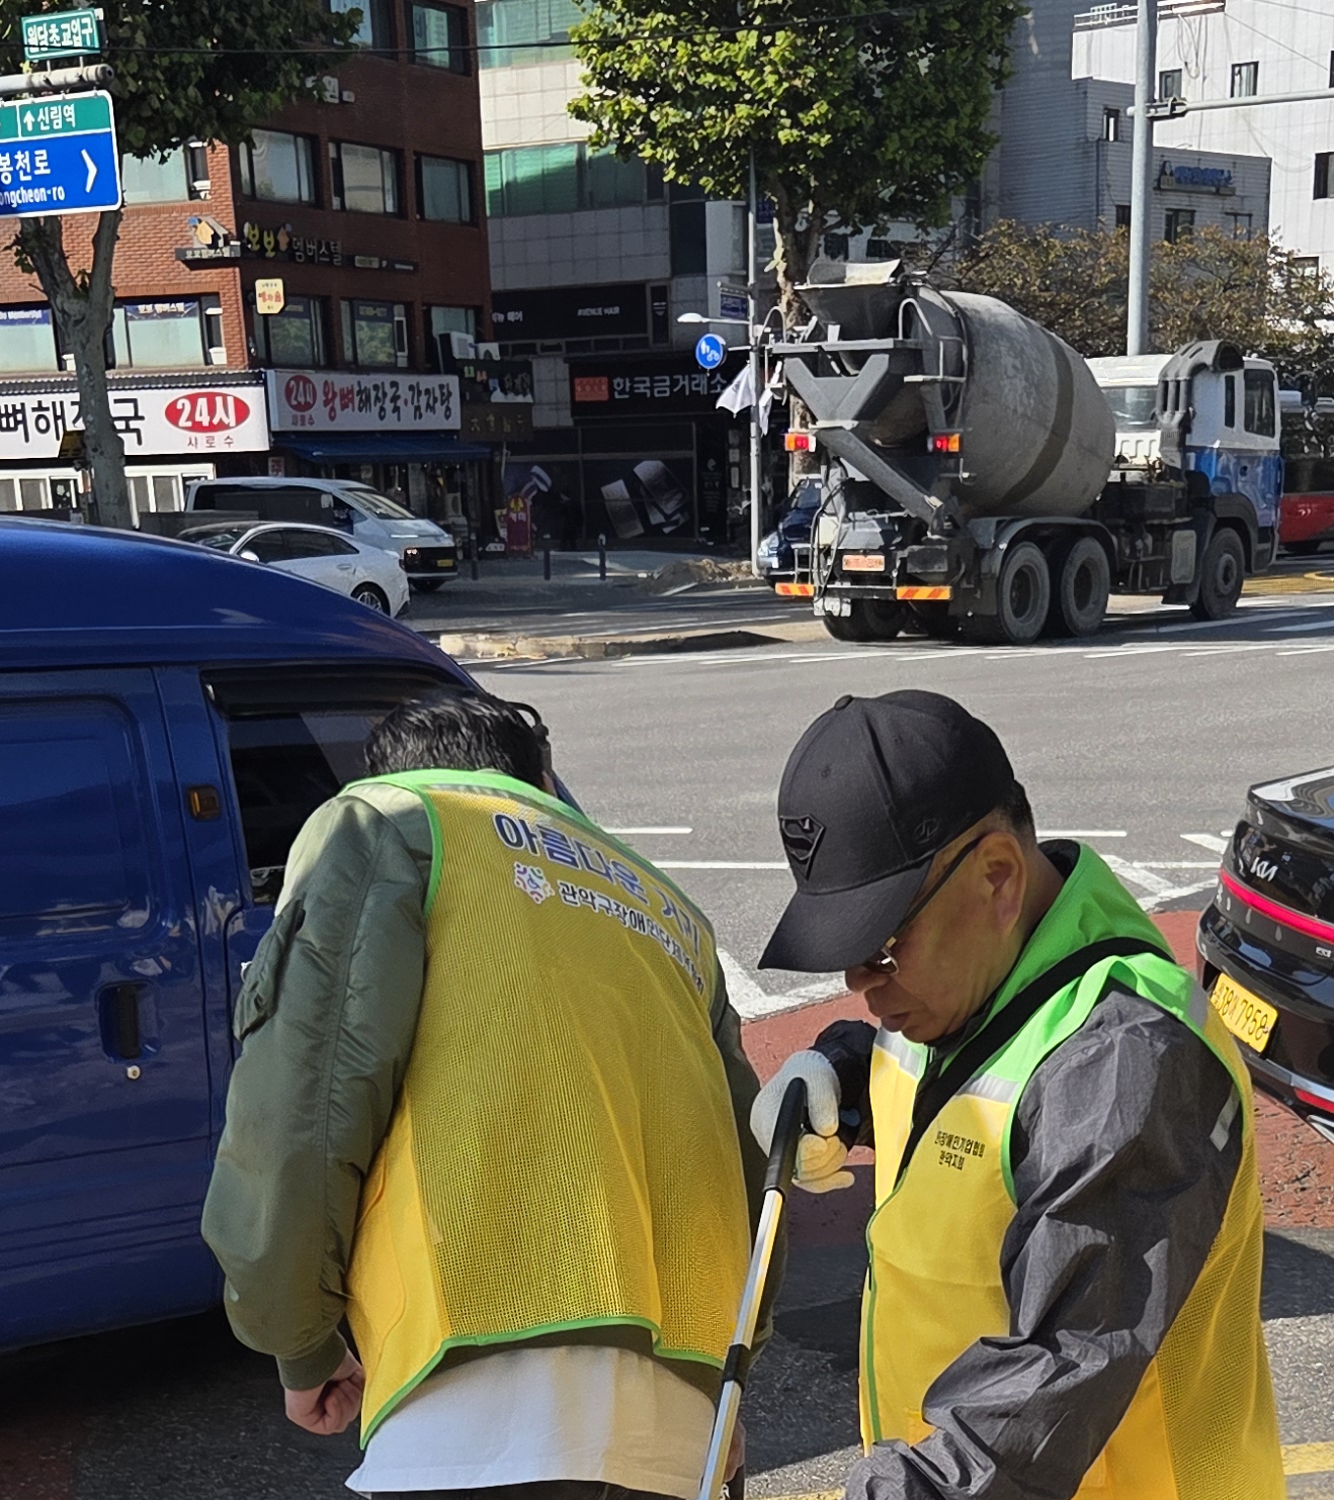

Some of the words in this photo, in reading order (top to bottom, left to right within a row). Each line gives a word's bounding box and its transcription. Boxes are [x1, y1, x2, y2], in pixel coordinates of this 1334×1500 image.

[37, 104, 76, 131] 신림역
[612, 374, 727, 399] 한국금거래소
[177, 395, 237, 428] 24시
[494, 812, 649, 906] 아름다운
[1234, 998, 1268, 1041] 7958
